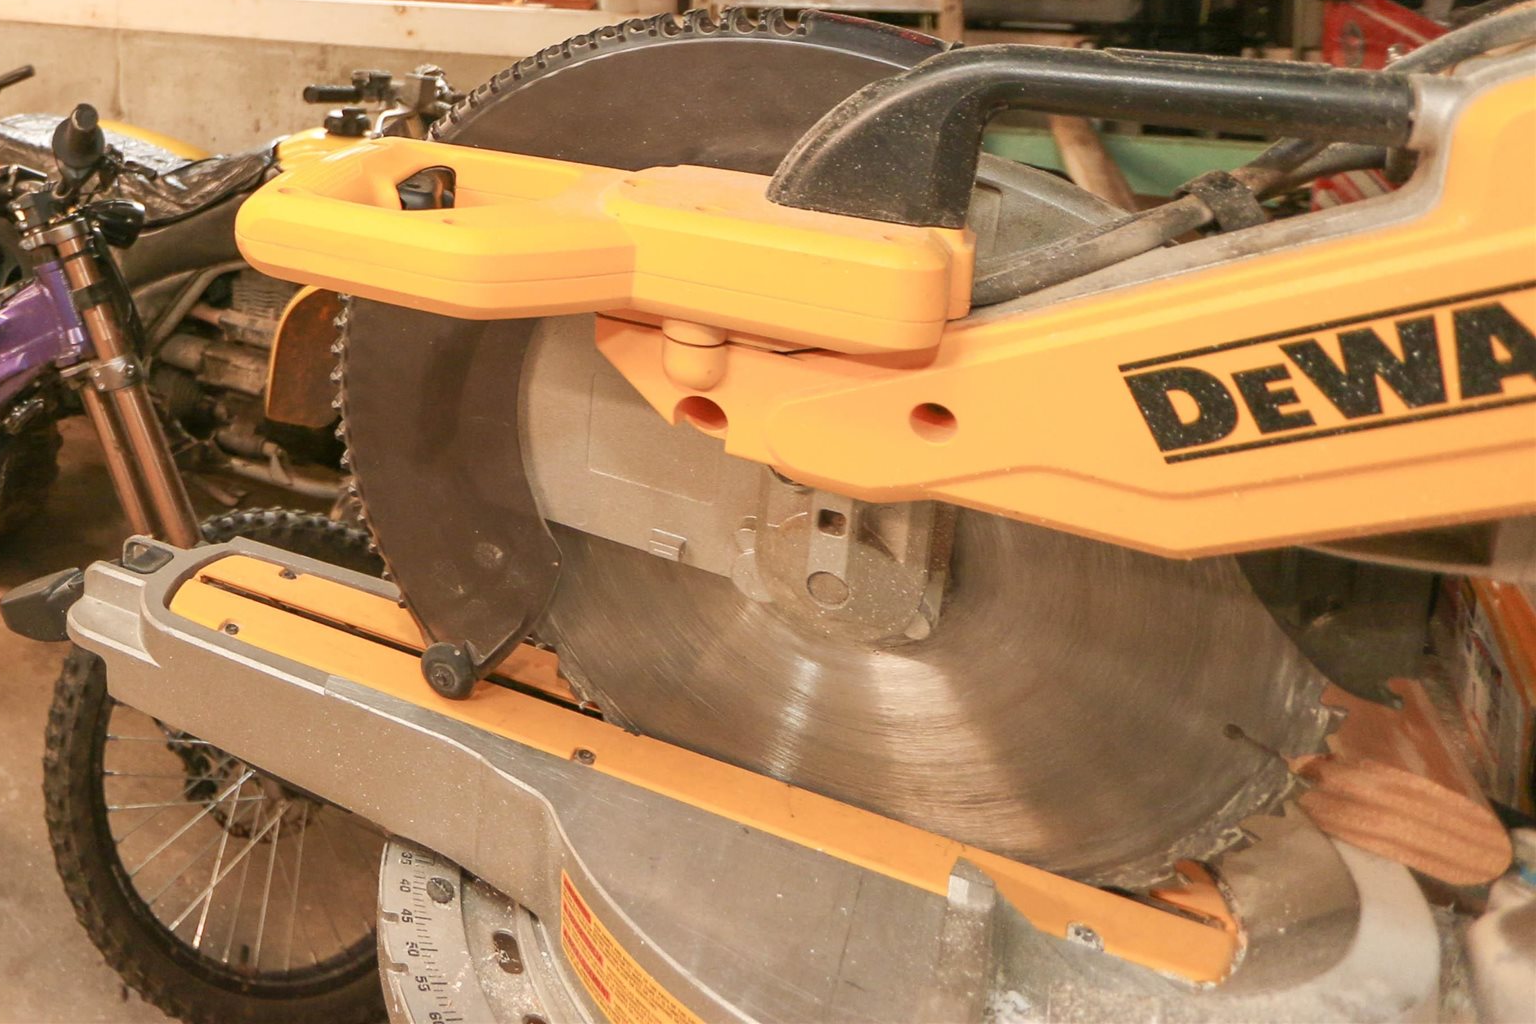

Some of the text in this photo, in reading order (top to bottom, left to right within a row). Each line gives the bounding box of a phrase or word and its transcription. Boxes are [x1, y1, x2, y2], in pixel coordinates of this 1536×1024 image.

[400, 851, 413, 865] 35
[399, 878, 412, 893] 40
[400, 908, 414, 923] 45
[415, 975, 431, 992] 55
